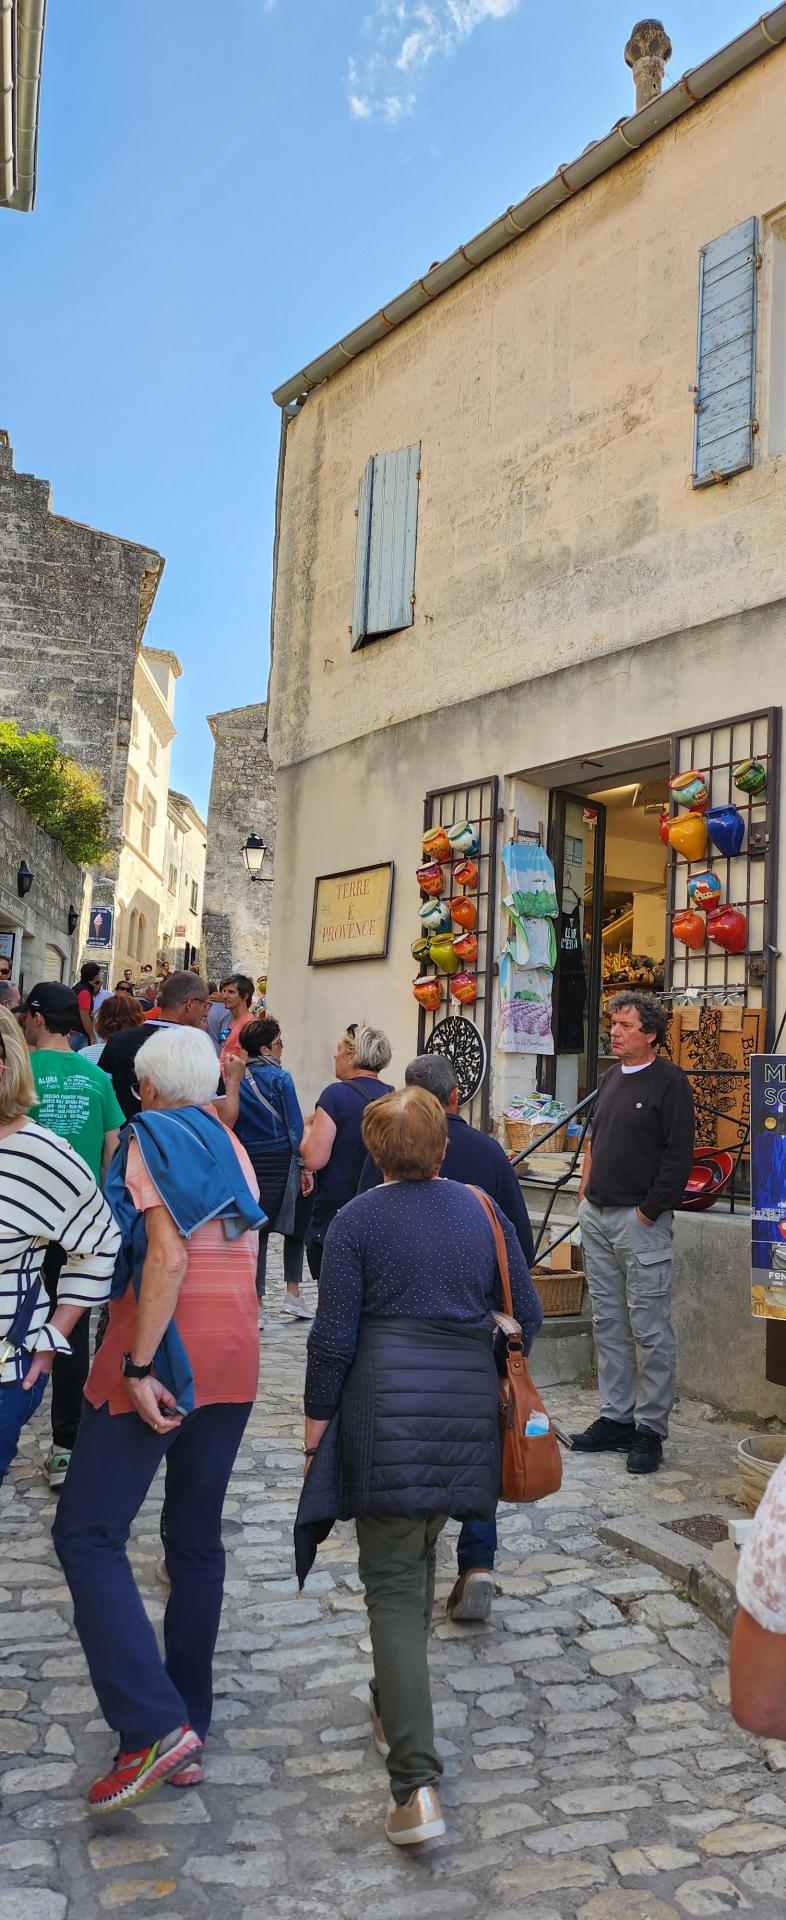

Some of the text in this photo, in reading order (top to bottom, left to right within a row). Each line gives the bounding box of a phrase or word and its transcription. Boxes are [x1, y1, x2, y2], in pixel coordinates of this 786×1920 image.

[336, 879, 369, 899] TERRE
[322, 920, 376, 942] PROVENCE
[764, 1064, 786, 1083] M
